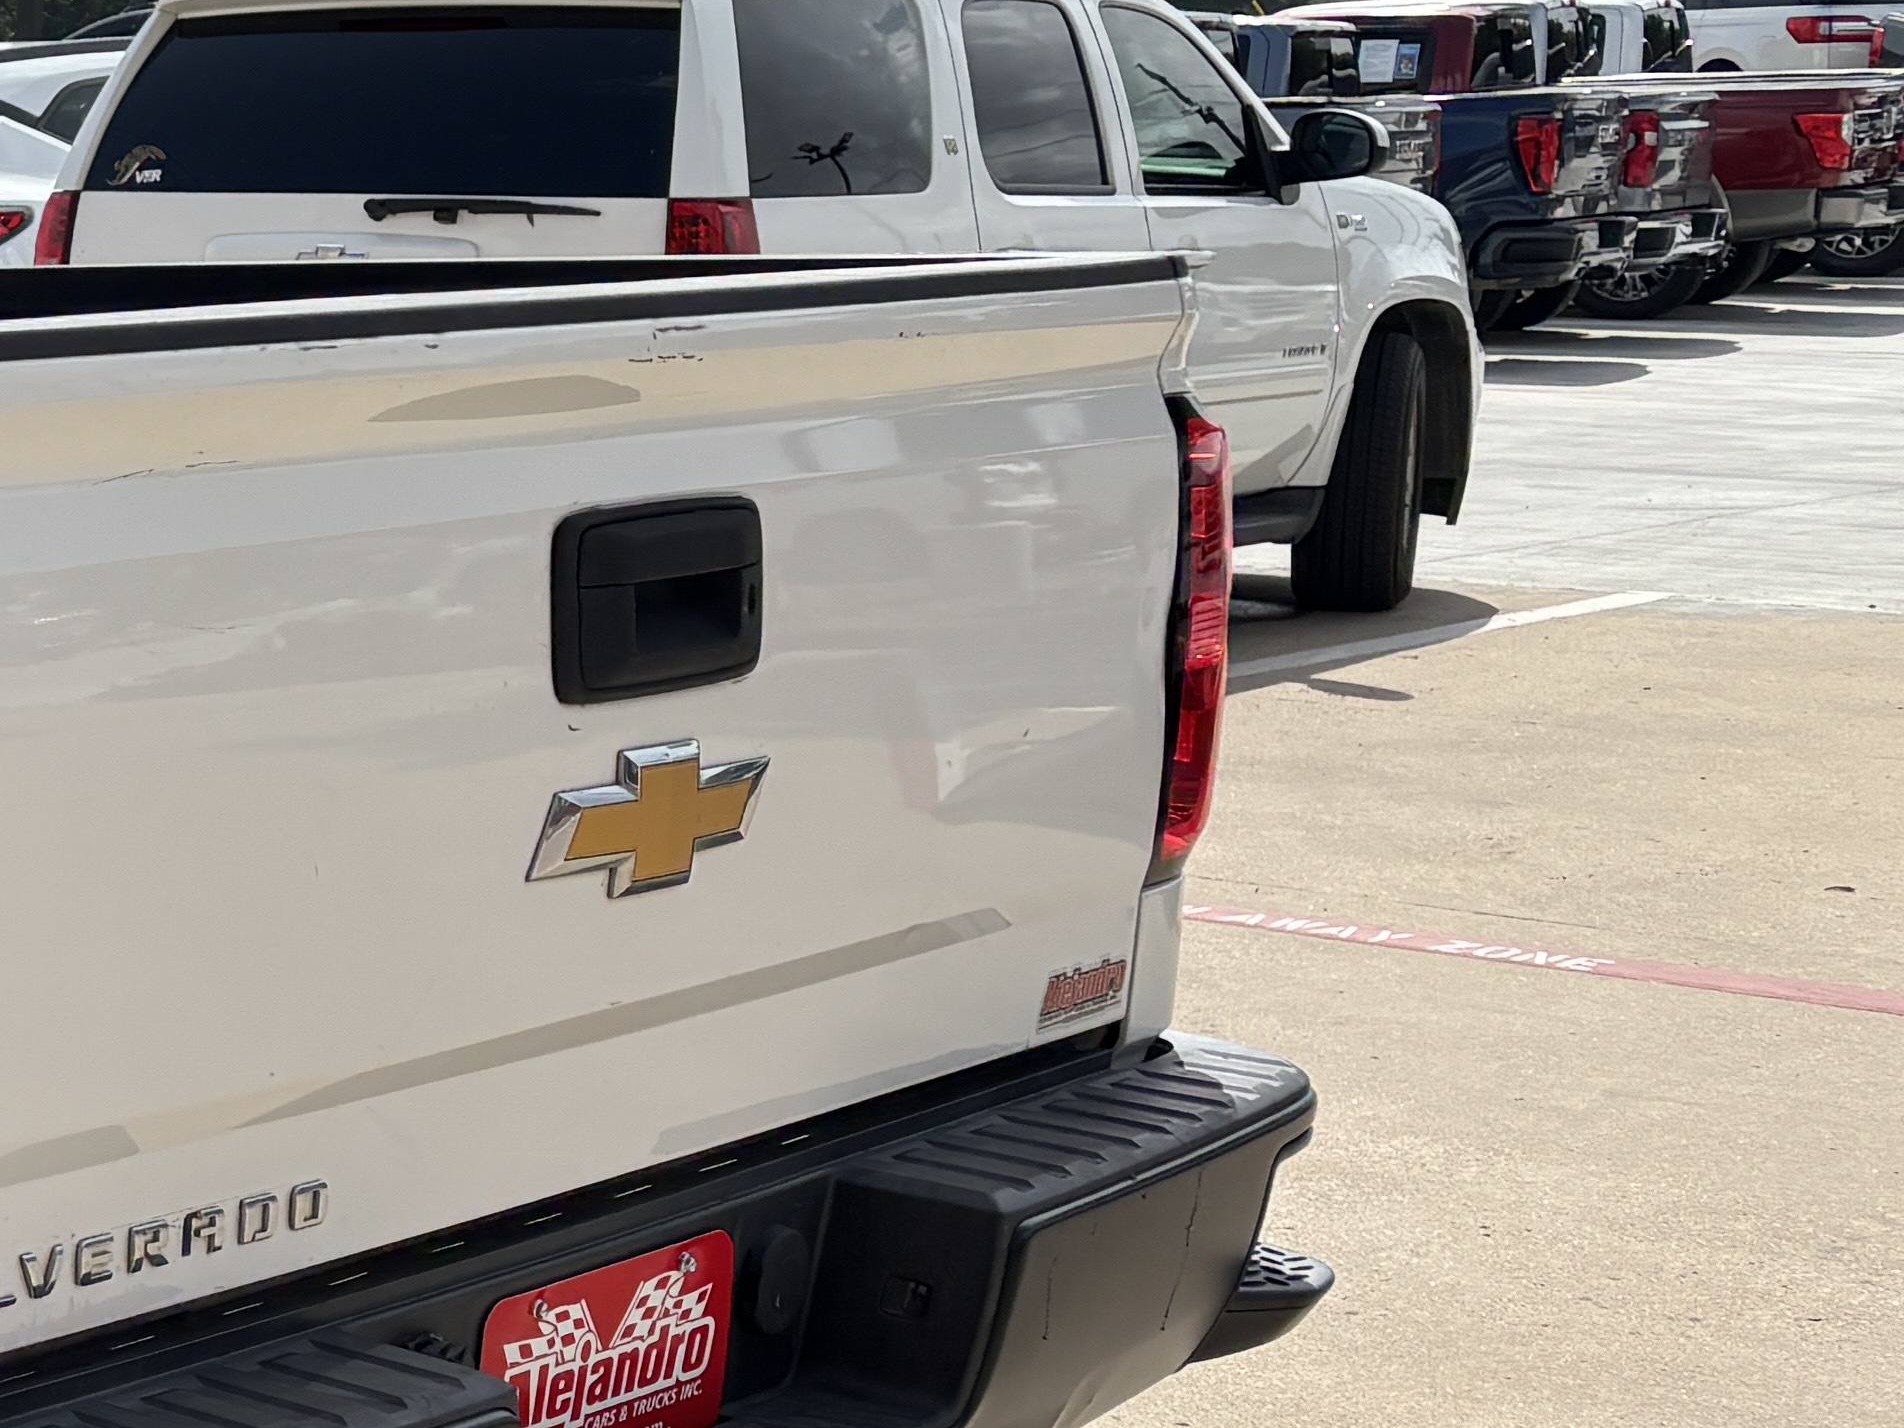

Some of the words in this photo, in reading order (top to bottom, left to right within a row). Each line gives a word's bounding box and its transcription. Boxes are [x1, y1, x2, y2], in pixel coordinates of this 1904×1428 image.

[1216, 912, 1415, 943] AWAY
[1429, 939, 1616, 972] ZONE
[618, 1406, 628, 1422] &
[632, 1387, 678, 1416] TRUCKS
[679, 1380, 703, 1402] INC.
